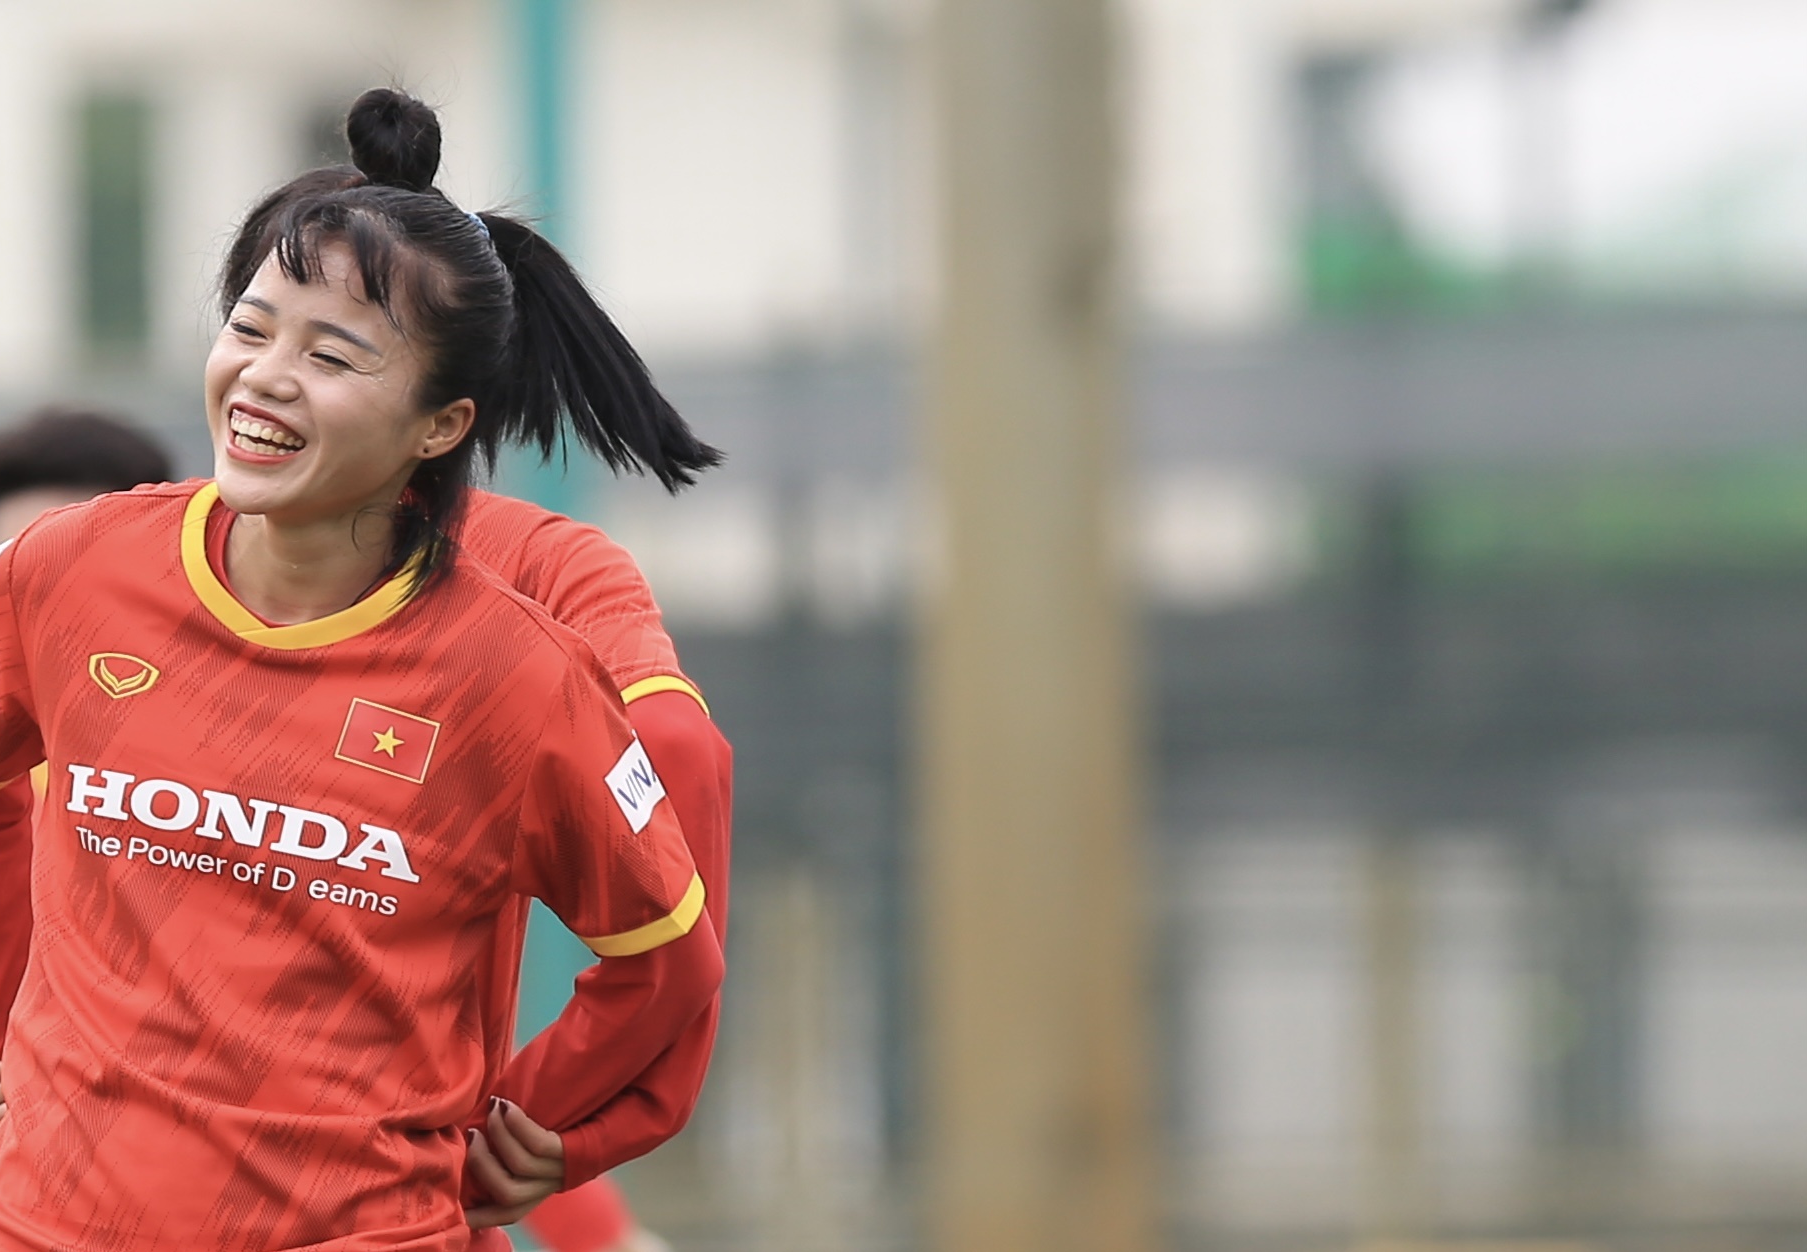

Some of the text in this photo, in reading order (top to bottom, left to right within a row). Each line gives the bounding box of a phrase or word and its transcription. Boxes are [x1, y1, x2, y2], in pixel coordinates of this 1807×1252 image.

[66, 764, 421, 884] HONDA
[75, 825, 122, 857] The
[126, 836, 228, 876] Power
[232, 861, 266, 886] of
